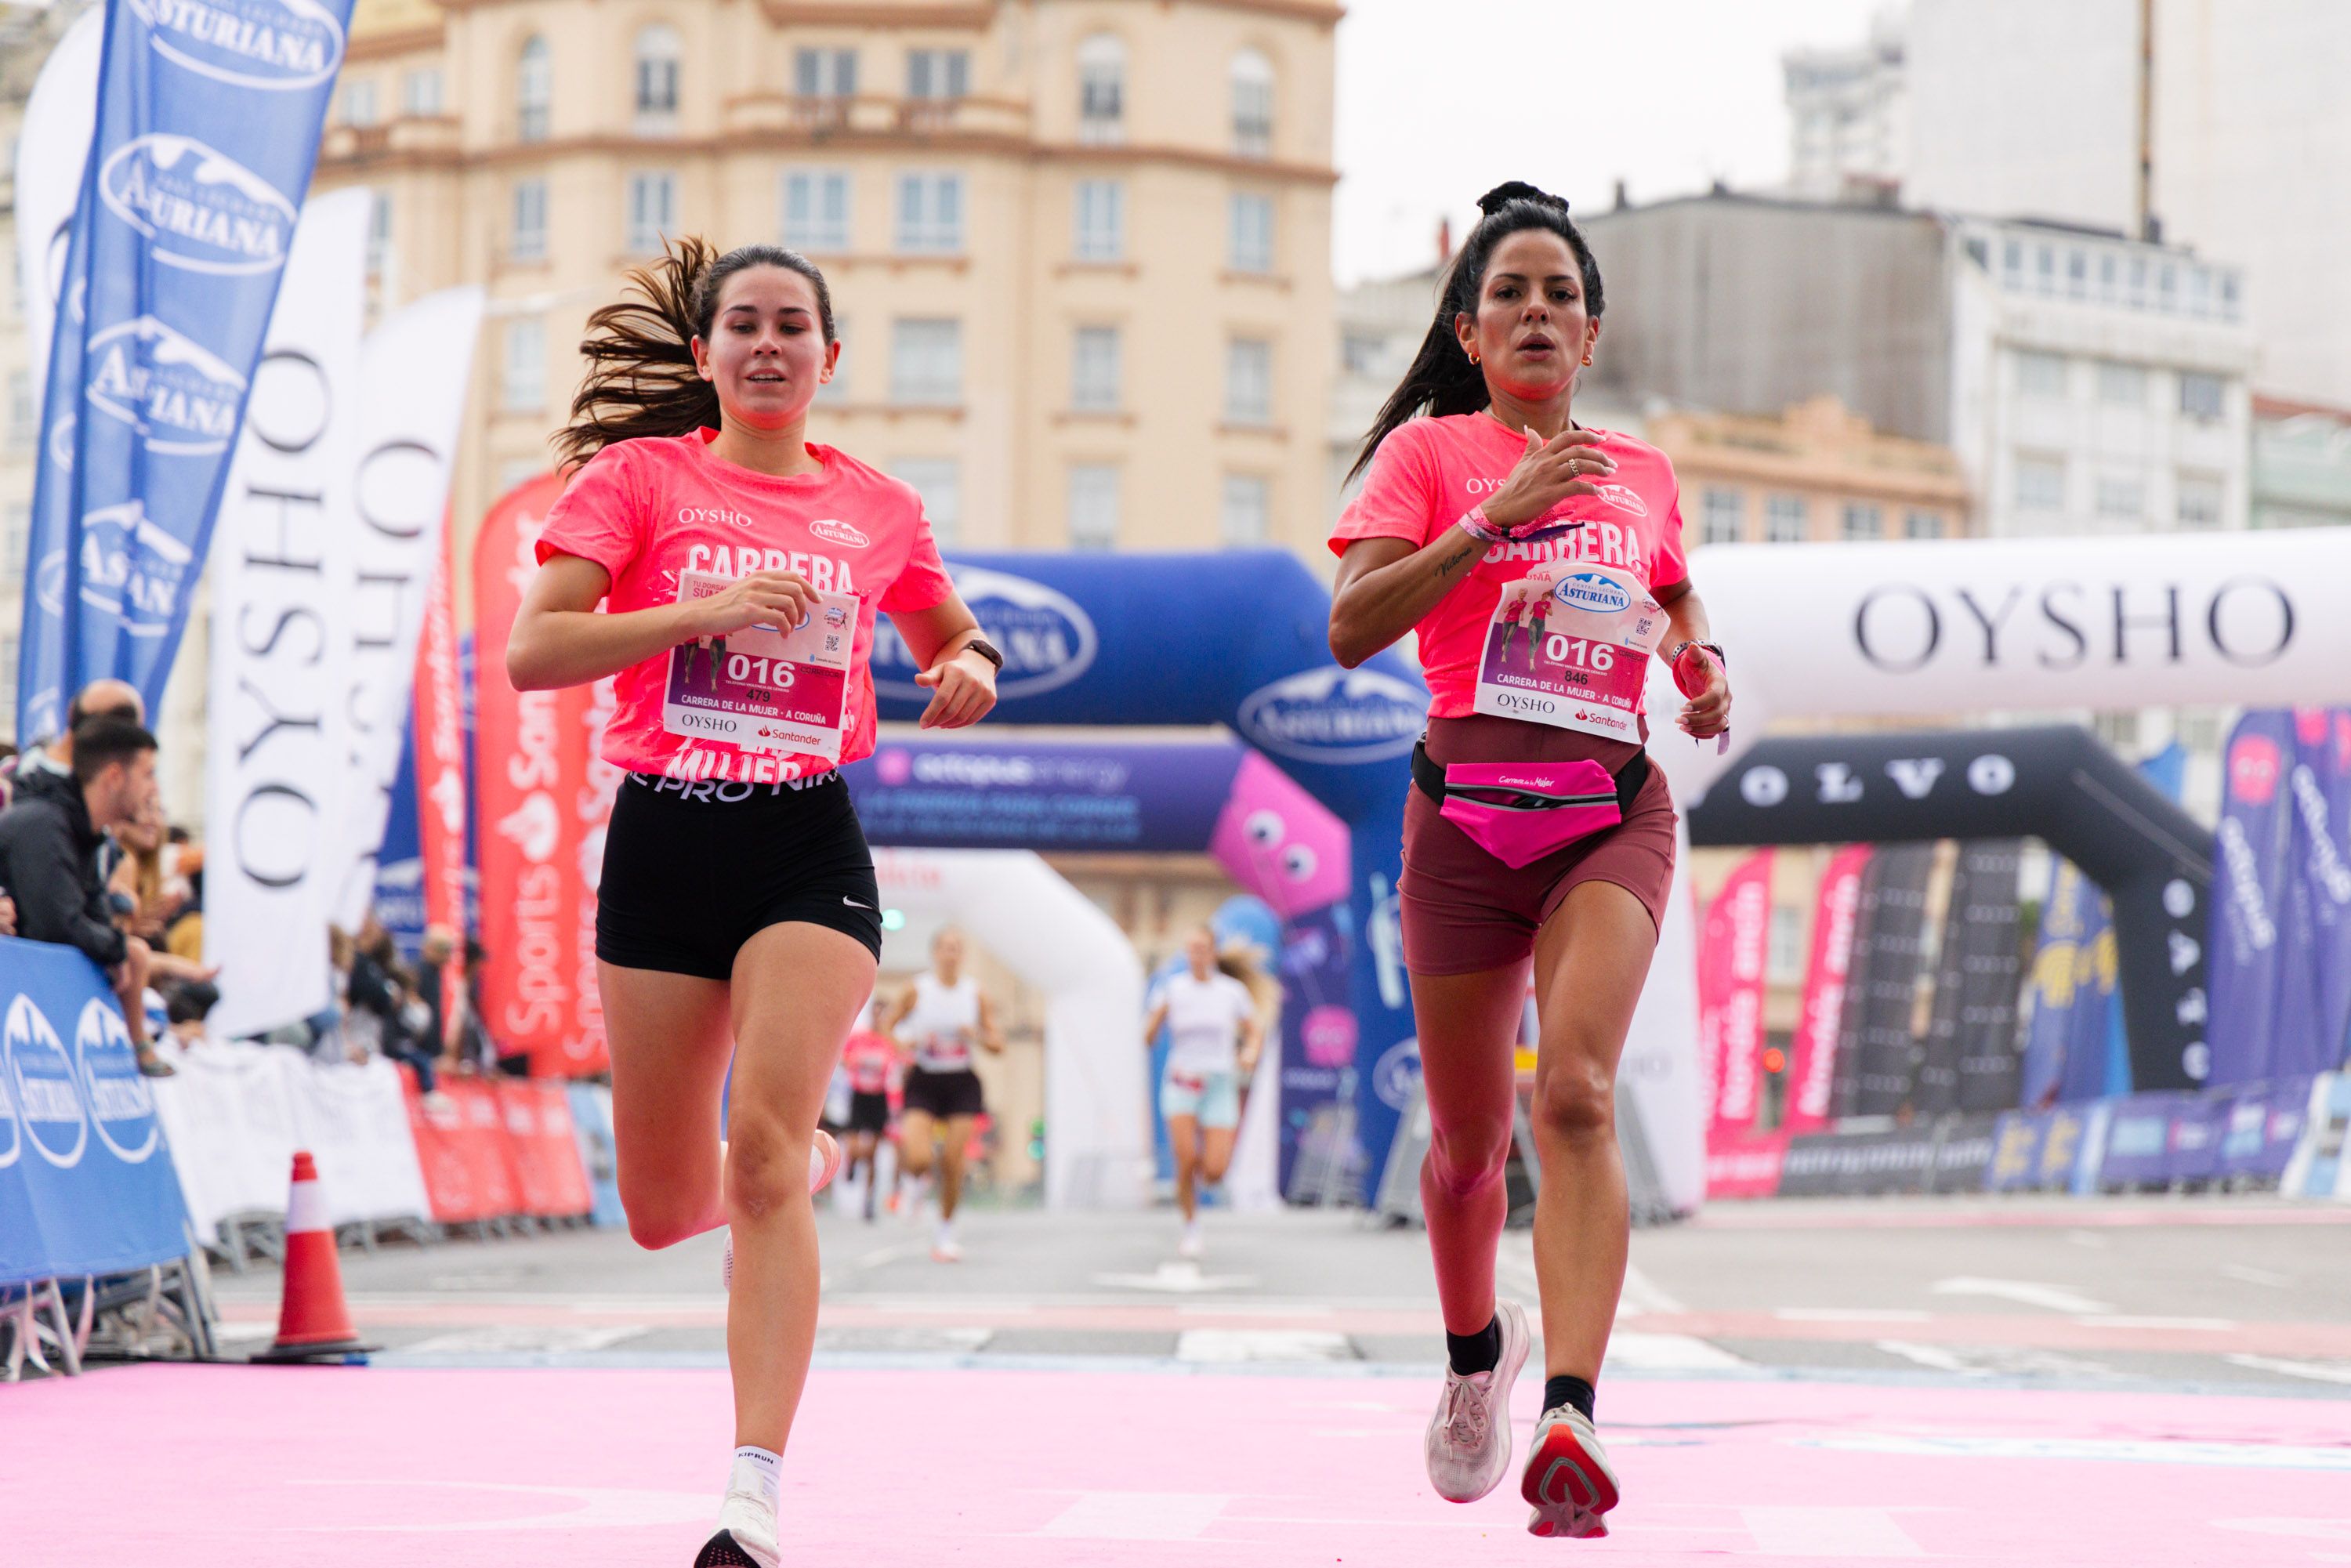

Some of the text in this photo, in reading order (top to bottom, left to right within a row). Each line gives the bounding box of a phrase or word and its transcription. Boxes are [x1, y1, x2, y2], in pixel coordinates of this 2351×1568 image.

[156, 0, 325, 72] STURIANA
[1466, 478, 1507, 494] OYS
[678, 508, 752, 527] OYSHO
[815, 524, 866, 546] ASTURIANA
[693, 588, 719, 598] SUM
[1559, 582, 1625, 607] ASTURIANA
[234, 349, 332, 889] OYSHO
[1853, 574, 2297, 675] OYSHO
[1546, 635, 1614, 671] 016
[727, 654, 795, 687] 016
[1564, 670, 1588, 686] 846
[746, 689, 771, 703] 479
[1497, 673, 1538, 689] CARRERA
[1540, 681, 1552, 690] DE
[1553, 683, 1564, 693] LA
[1567, 686, 1596, 701] MUJER
[1602, 694, 1609, 703] A
[681, 694, 827, 725] CARRERA DE LA MUJER A CORUÑA
[1497, 693, 1556, 714] OYSHO
[682, 713, 737, 733] OYSHO
[1589, 713, 1628, 731] Santander
[773, 729, 821, 745] Santander
[654, 776, 754, 803] PRO
[770, 769, 838, 796] NIK
[1684, 753, 2016, 810] OLVO
[738, 1452, 774, 1465] KIPRUN
